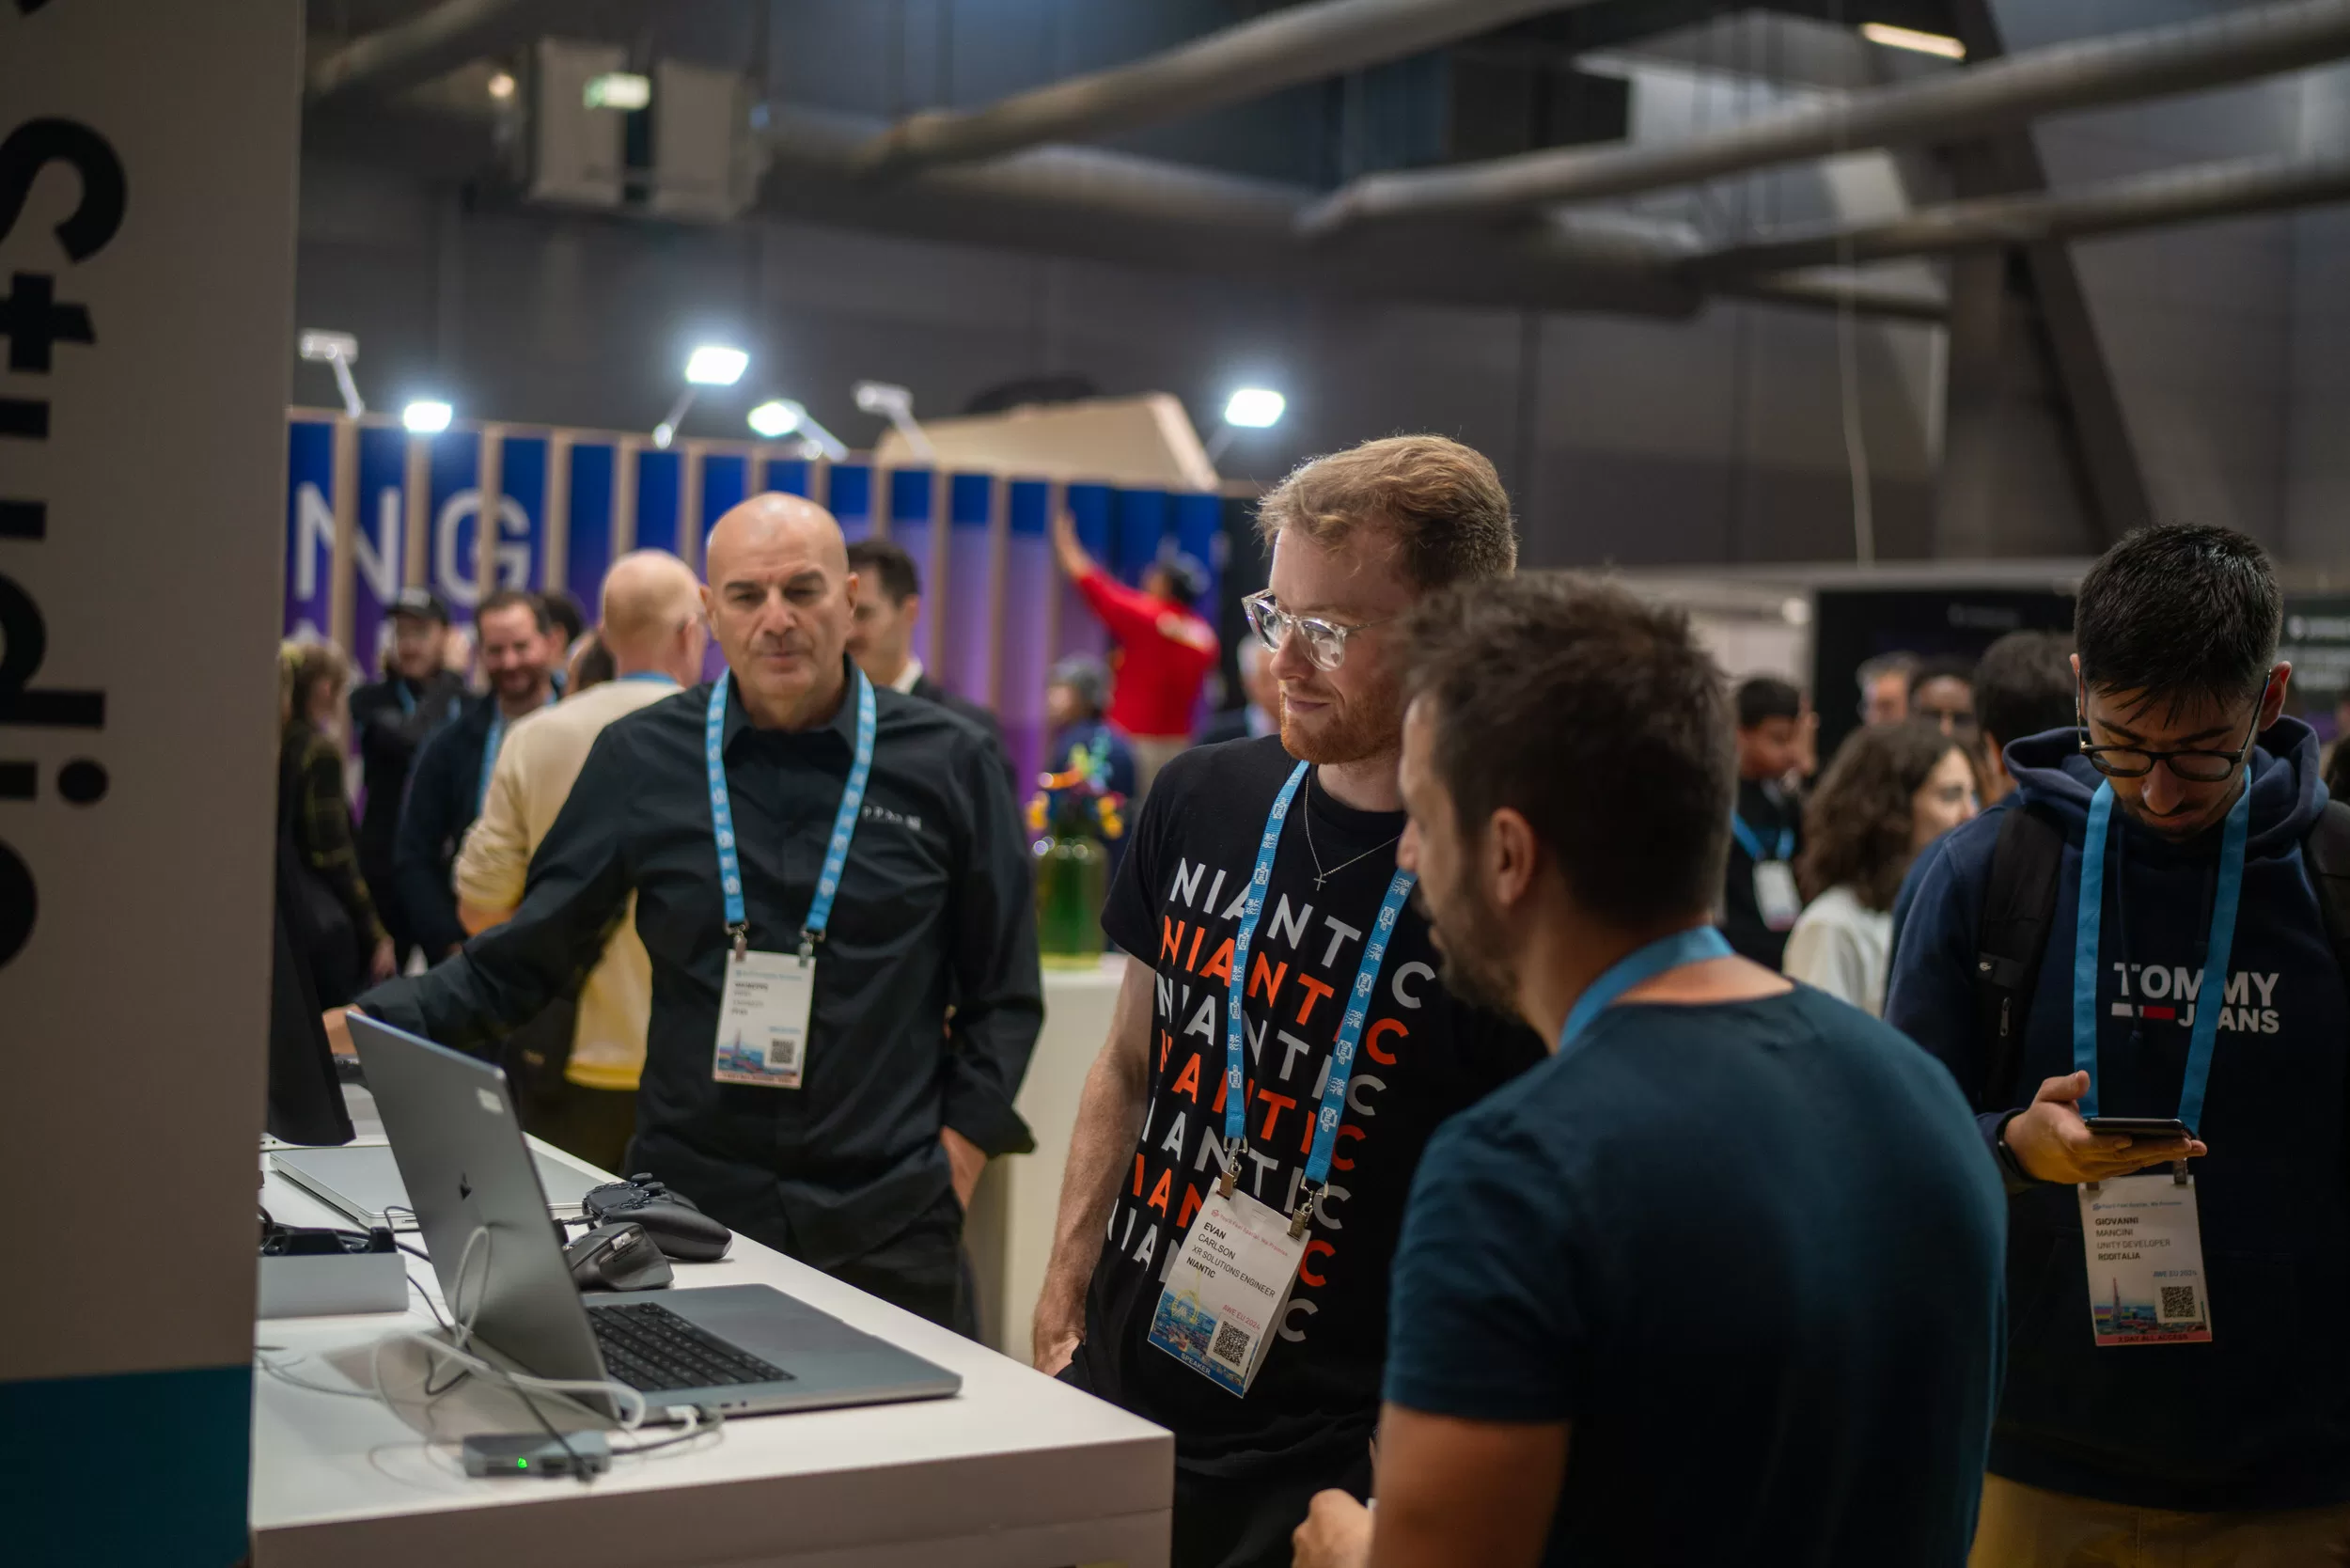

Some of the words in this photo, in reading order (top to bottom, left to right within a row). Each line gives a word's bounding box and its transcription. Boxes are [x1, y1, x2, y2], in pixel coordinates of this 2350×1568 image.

[1169, 857, 1435, 1009] NIANTC
[1161, 915, 1409, 1064] NIANTC
[2177, 1003, 2280, 1034] JANS
[1203, 1222, 1228, 1240] EVAN
[2095, 1216, 2139, 1227] GIOVANNI
[2096, 1229, 2134, 1237] MANCINI
[1198, 1233, 1236, 1260] CARLSON
[2123, 1239, 2170, 1248] DEVELOPER
[1186, 1257, 1216, 1278] NIANTIC
[1192, 1245, 1202, 1257] XR
[1201, 1249, 1240, 1278] SOLUTIONS
[1240, 1272, 1276, 1298] ENGINEER
[1222, 1303, 1236, 1317] AWE
[1236, 1310, 1246, 1323] EU
[1245, 1315, 1261, 1330] 2024
[1181, 1352, 1211, 1375] SPEAKER
